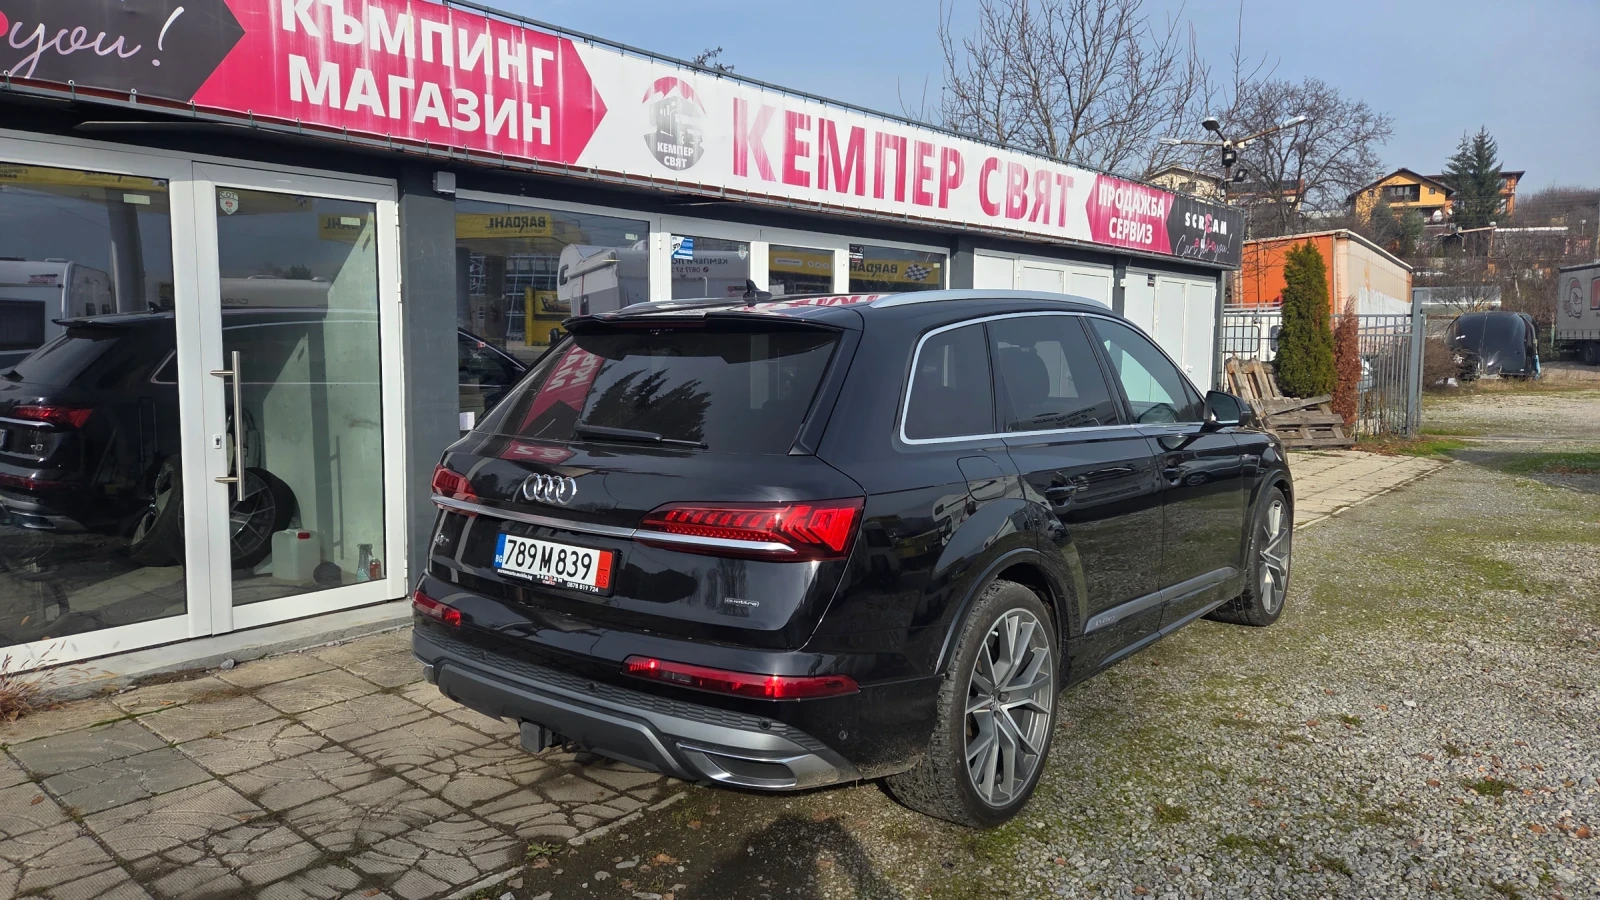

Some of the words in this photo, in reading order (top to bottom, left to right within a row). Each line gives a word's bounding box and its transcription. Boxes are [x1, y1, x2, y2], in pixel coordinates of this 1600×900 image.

[9, 6, 185, 79] you!
[281, 0, 554, 87] КЪМПИНГ
[288, 53, 551, 145] МАГАЗИН
[657, 142, 694, 157] КЕМПЕР
[663, 156, 687, 168] СВЯТ
[733, 97, 966, 210] КЕМПЕР
[979, 156, 1075, 228] СВЯТ
[1098, 184, 1165, 219] ПРОДАЖБА
[1109, 217, 1153, 244] СЕРВИЗ
[1184, 212, 1227, 235] SCREAM
[495, 554, 503, 563] BG
